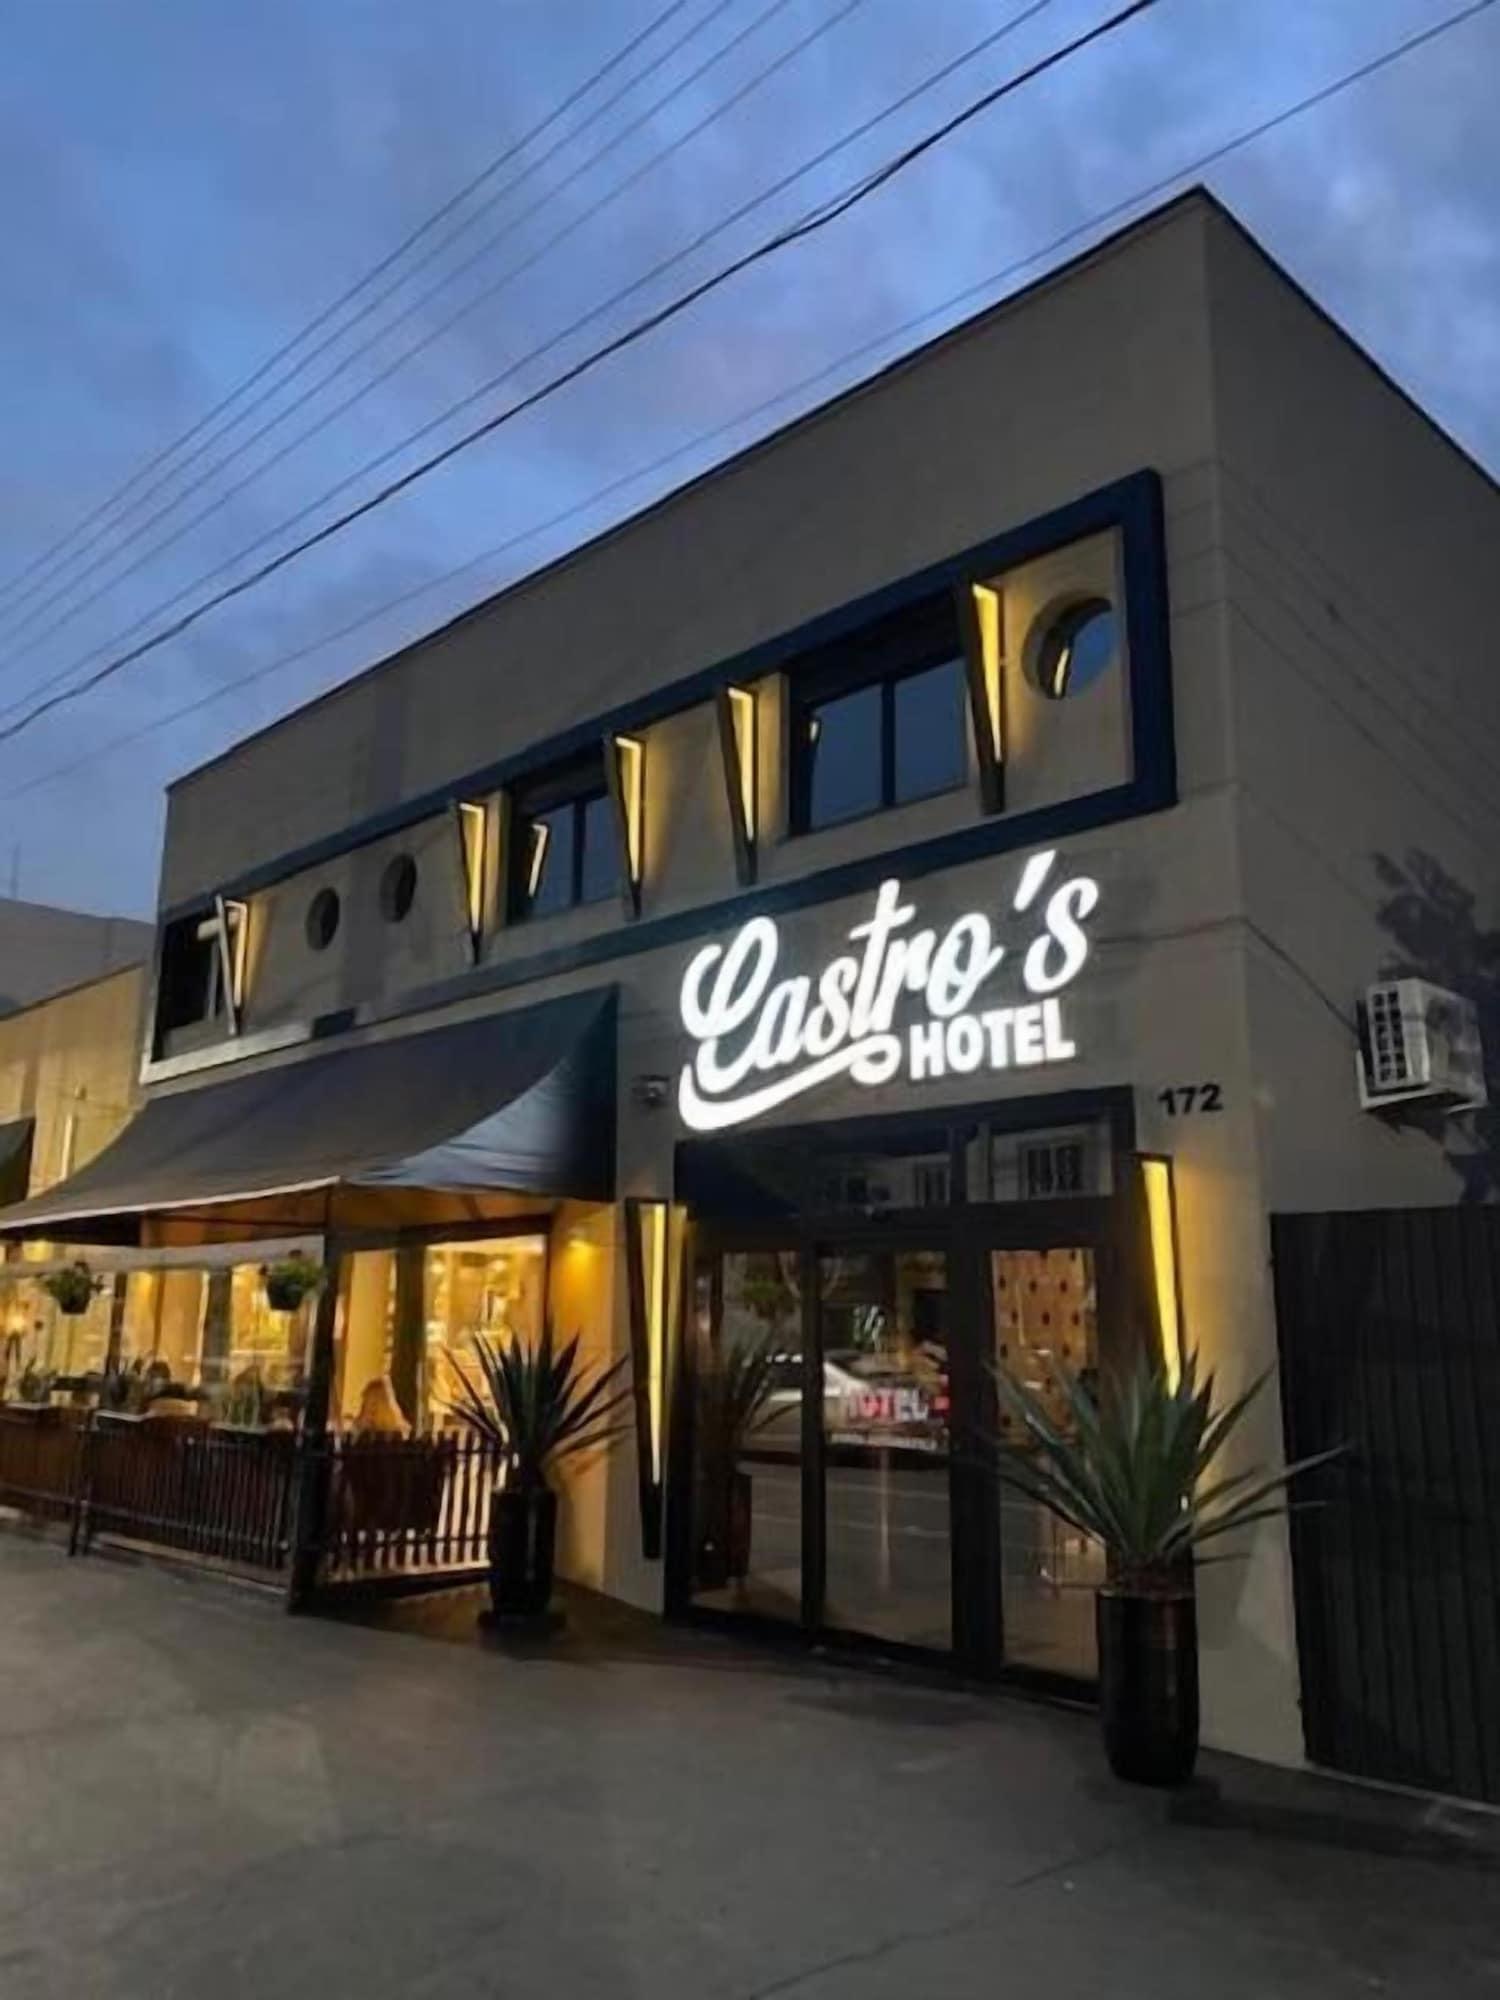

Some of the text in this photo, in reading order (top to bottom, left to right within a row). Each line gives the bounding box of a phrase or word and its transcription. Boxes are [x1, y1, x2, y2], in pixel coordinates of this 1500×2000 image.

[680, 849, 1099, 1094] Castro's
[909, 999, 1076, 1081] HOTEL
[1158, 1084, 1224, 1116] 172
